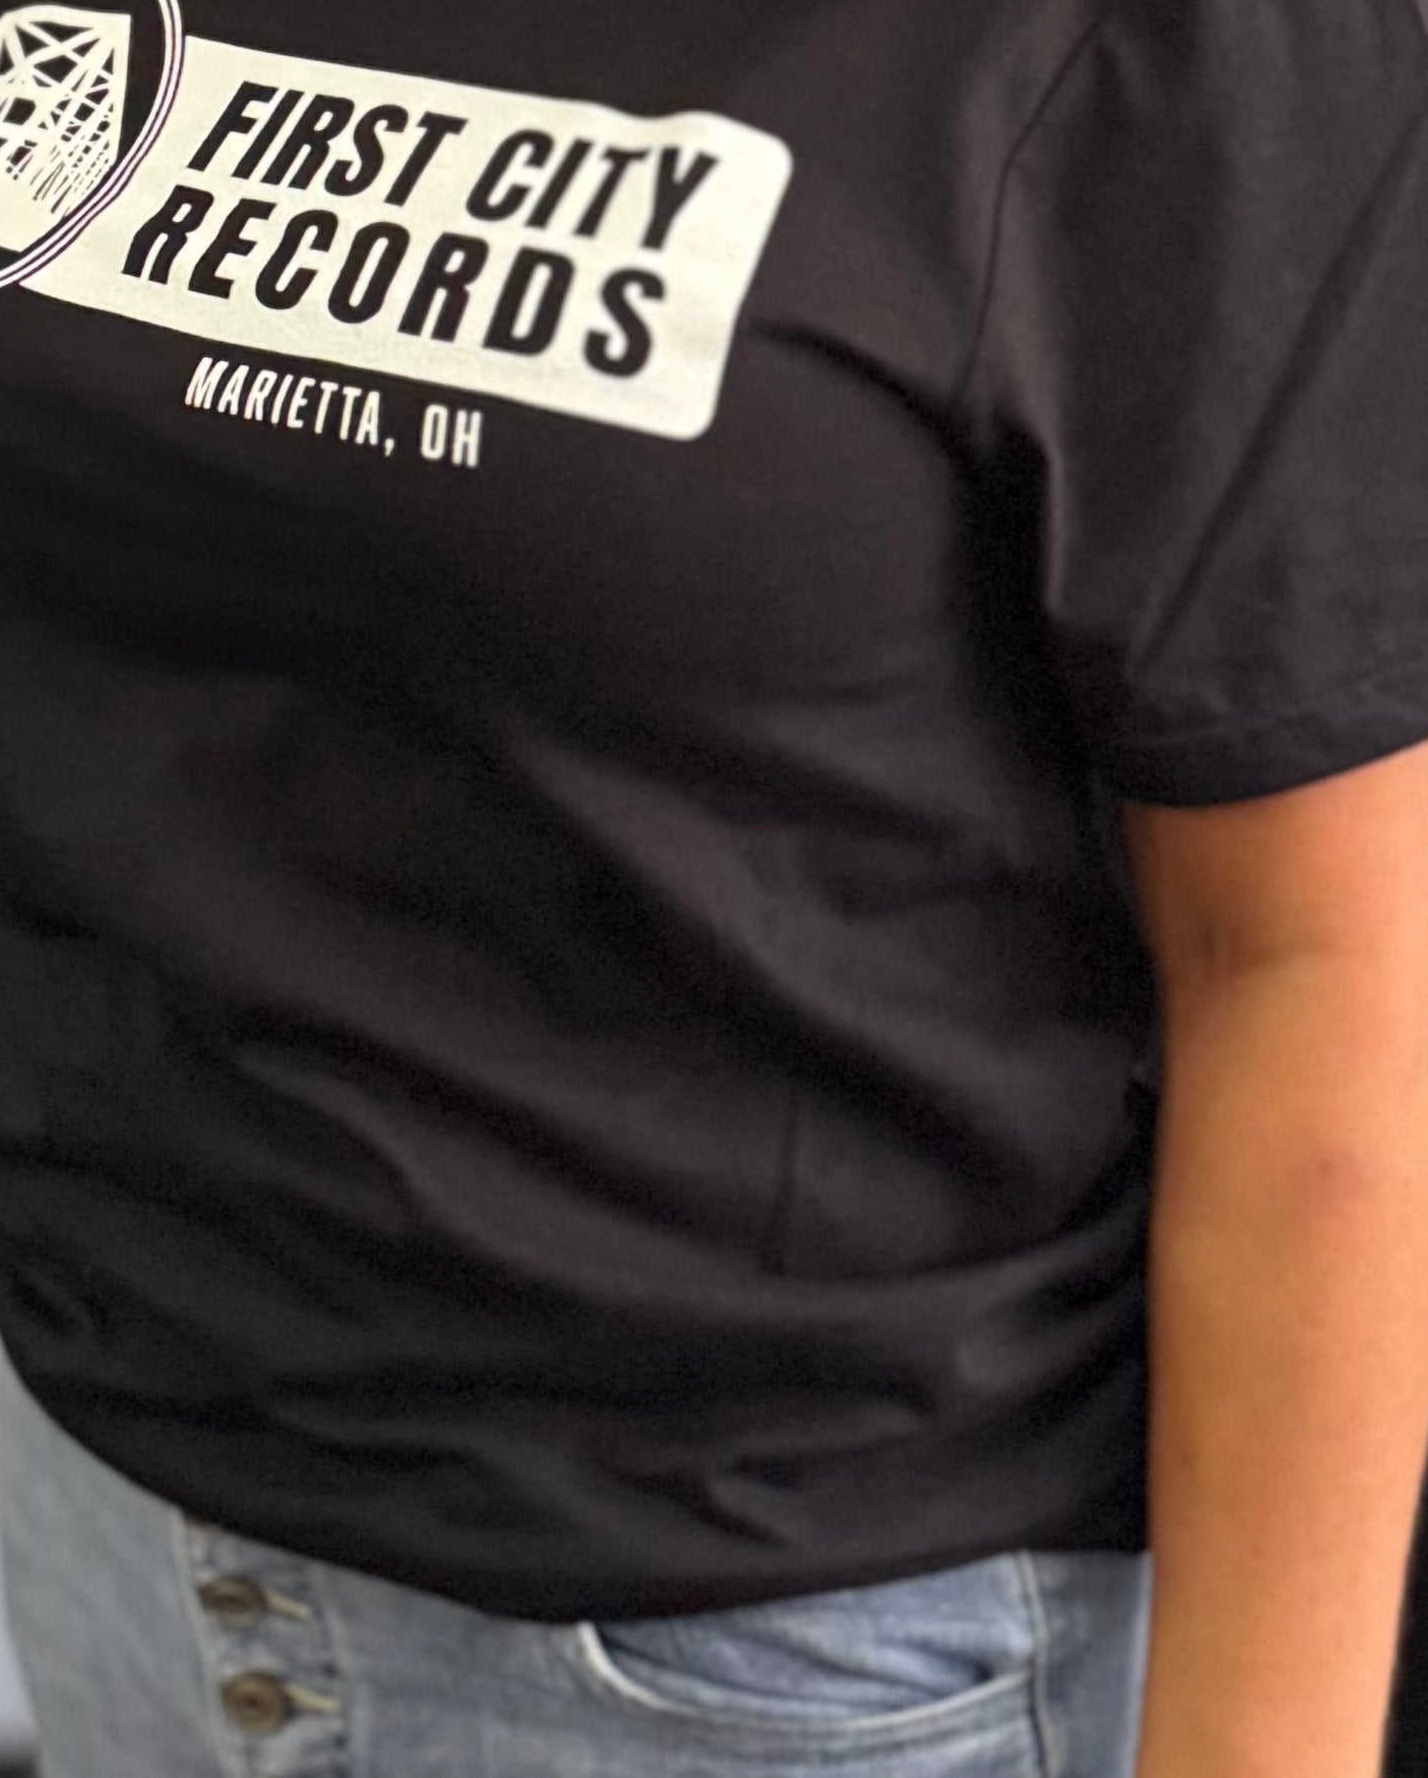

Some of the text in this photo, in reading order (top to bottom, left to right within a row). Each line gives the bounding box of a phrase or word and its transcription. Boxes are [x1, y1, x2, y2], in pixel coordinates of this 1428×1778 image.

[186, 79, 720, 252] FIRST CITY
[120, 183, 667, 379] RECORDS
[183, 355, 483, 469] MARIETTA, OH
